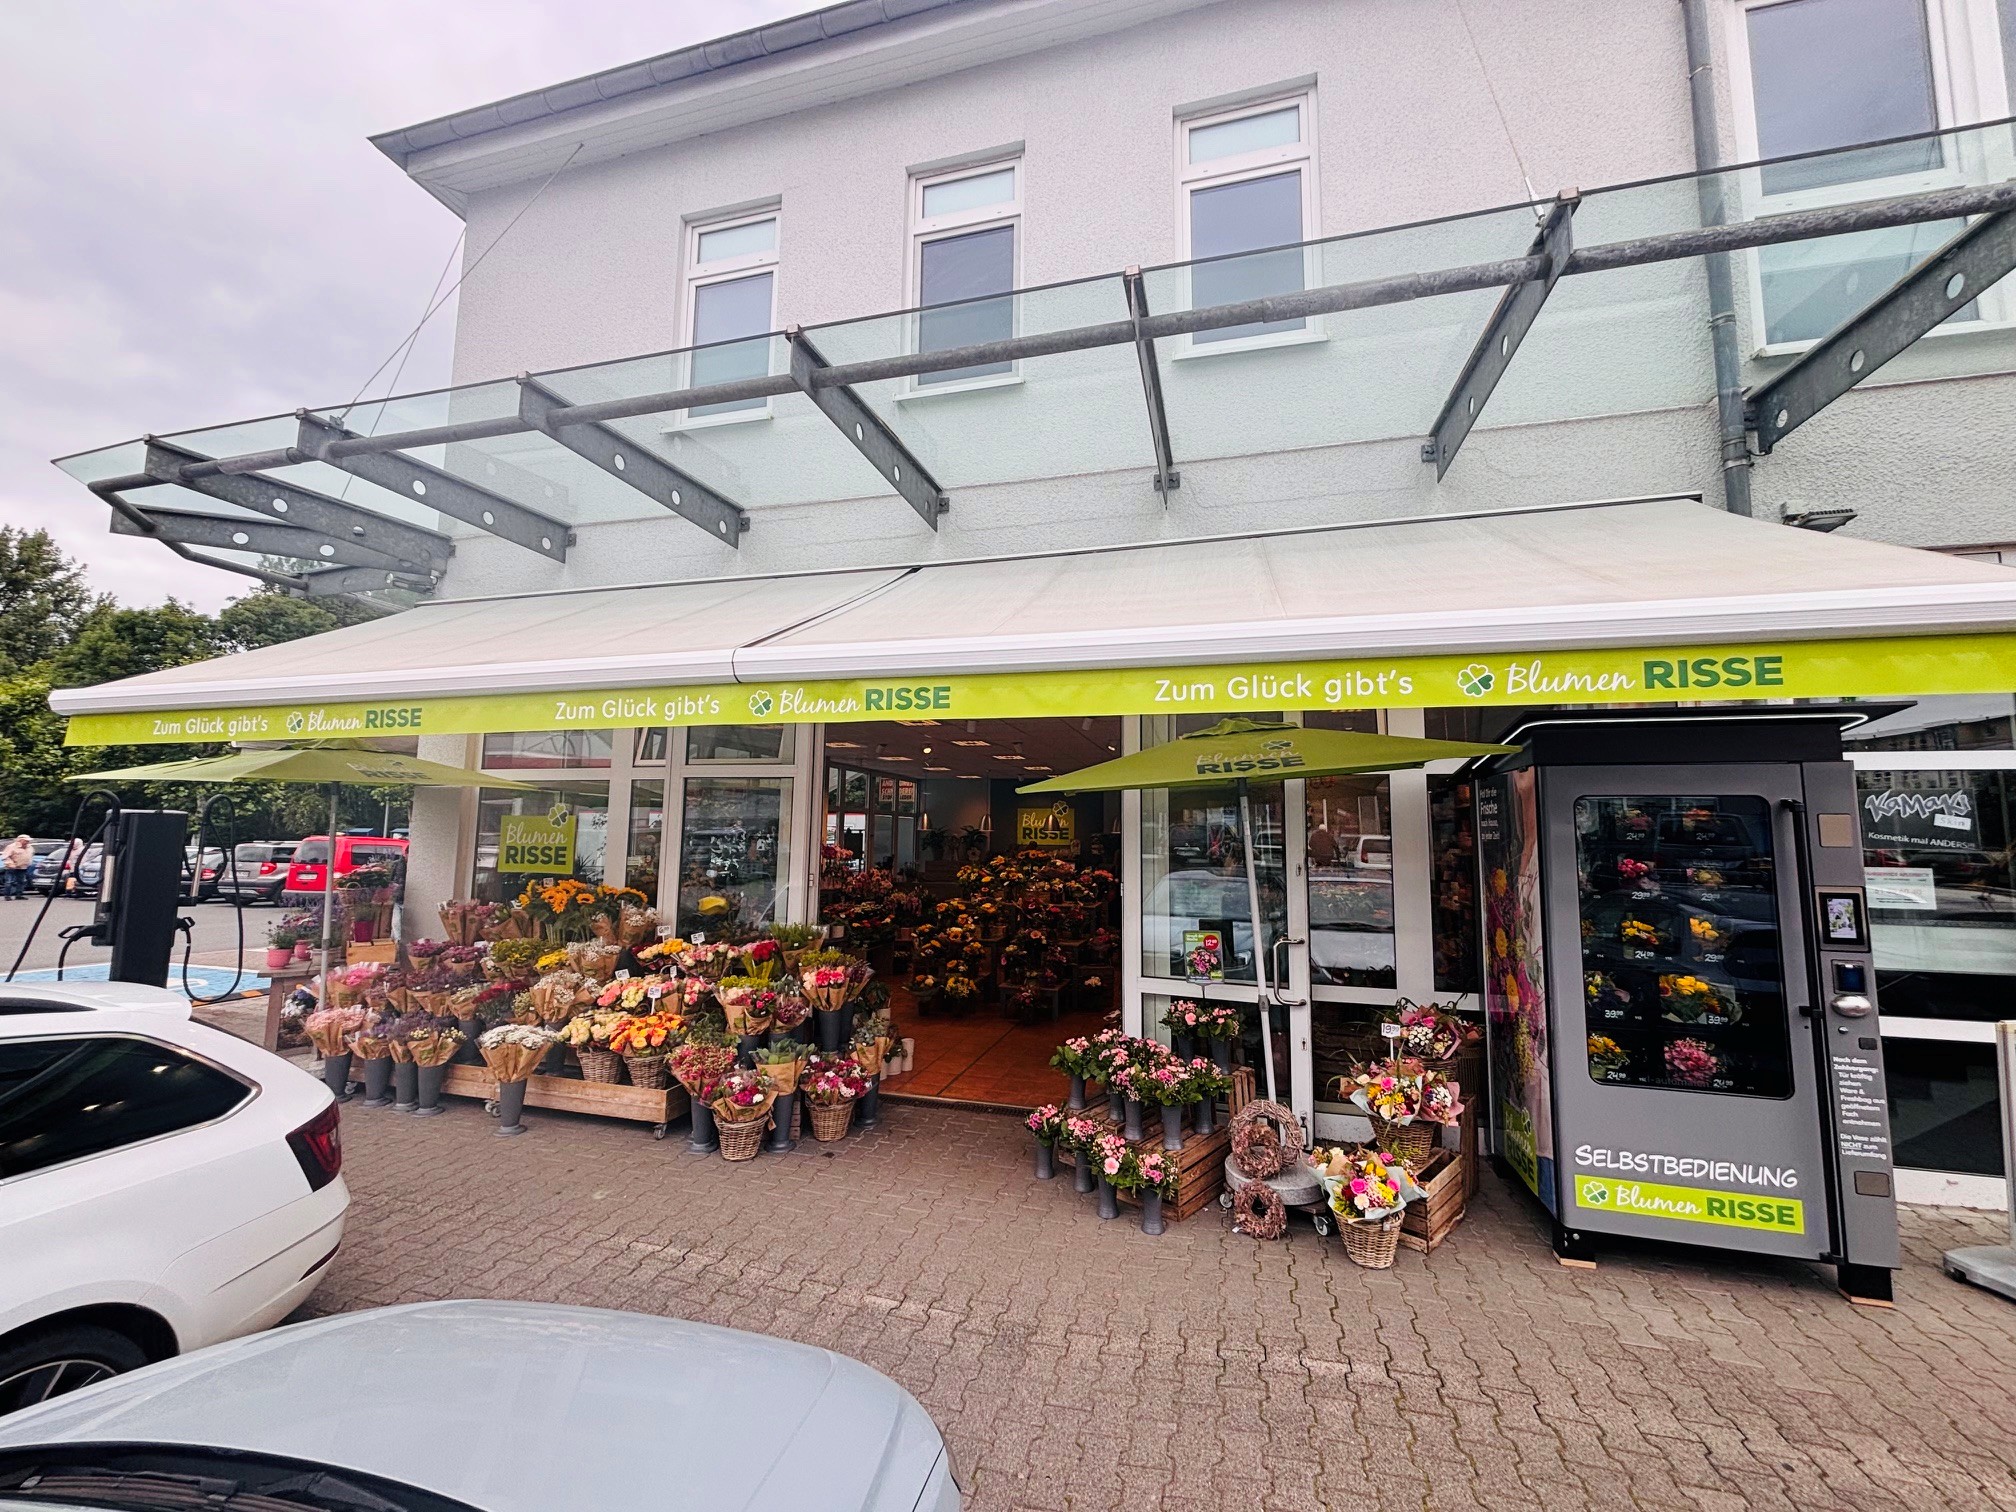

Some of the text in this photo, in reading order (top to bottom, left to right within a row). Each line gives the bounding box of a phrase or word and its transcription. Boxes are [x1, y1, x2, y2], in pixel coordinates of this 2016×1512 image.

[1154, 680, 1215, 702] Zum
[1227, 673, 1312, 700] Glück
[1504, 660, 1636, 694] Blumen
[1643, 656, 1783, 689] RISSE
[554, 702, 595, 720] Zum
[601, 697, 657, 718] Glück
[779, 688, 861, 715] Blumen
[865, 686, 951, 711] RISSE
[153, 720, 181, 735] Zum
[185, 717, 224, 734] Glück
[307, 710, 362, 732] Blumen
[365, 708, 422, 729] RISSE
[1196, 750, 1300, 765] Blumen
[1196, 755, 1305, 775] RISSE
[1480, 800, 1498, 815] Frische
[1022, 812, 1069, 828] Blun
[506, 822, 568, 845] Blumen
[1022, 827, 1069, 840] RISSE
[1868, 832, 1909, 843] Kosmetik
[505, 845, 567, 866] RISSE
[1841, 1141, 1862, 1149] NICHT
[1574, 1144, 1798, 1189] SELBSTBEDIENUNG
[1615, 1185, 1796, 1226] Blumen RISSE
